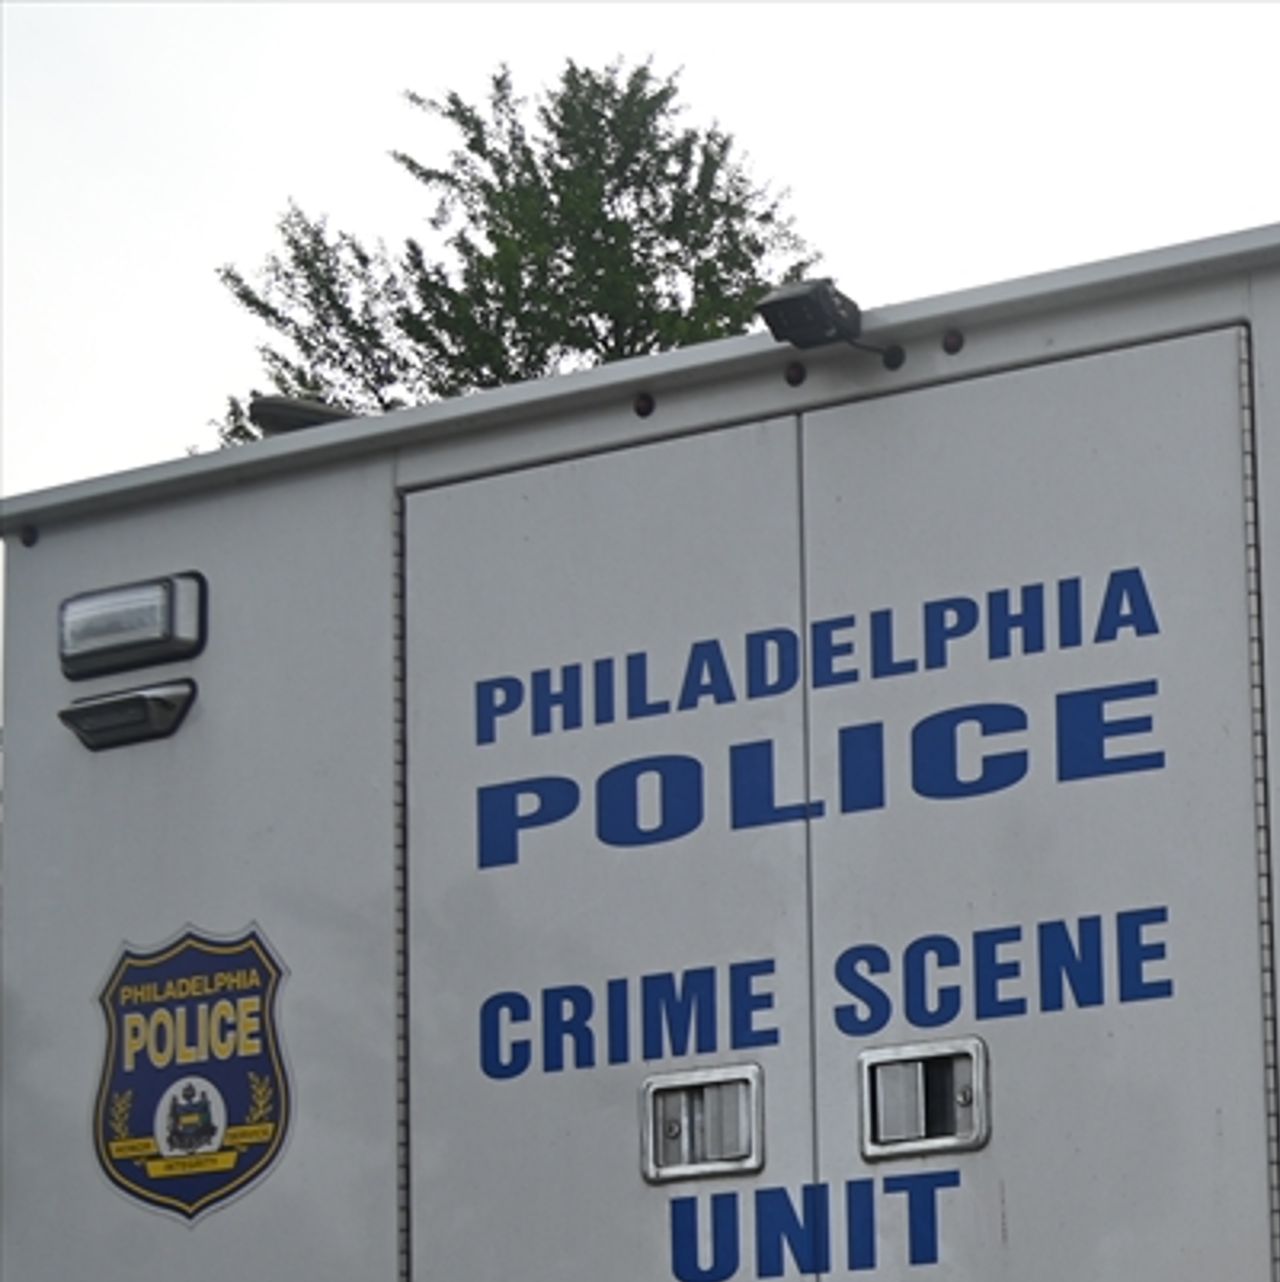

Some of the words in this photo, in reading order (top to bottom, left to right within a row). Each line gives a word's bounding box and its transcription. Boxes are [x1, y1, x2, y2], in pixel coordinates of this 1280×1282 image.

[476, 567, 1160, 745] PHILADELPHIA
[478, 679, 1167, 868] POLICE
[120, 968, 261, 1005] PHILADELPHIA
[123, 996, 261, 1072] POLICE
[479, 959, 782, 1080] CRIME
[834, 906, 1175, 1037] SCENE
